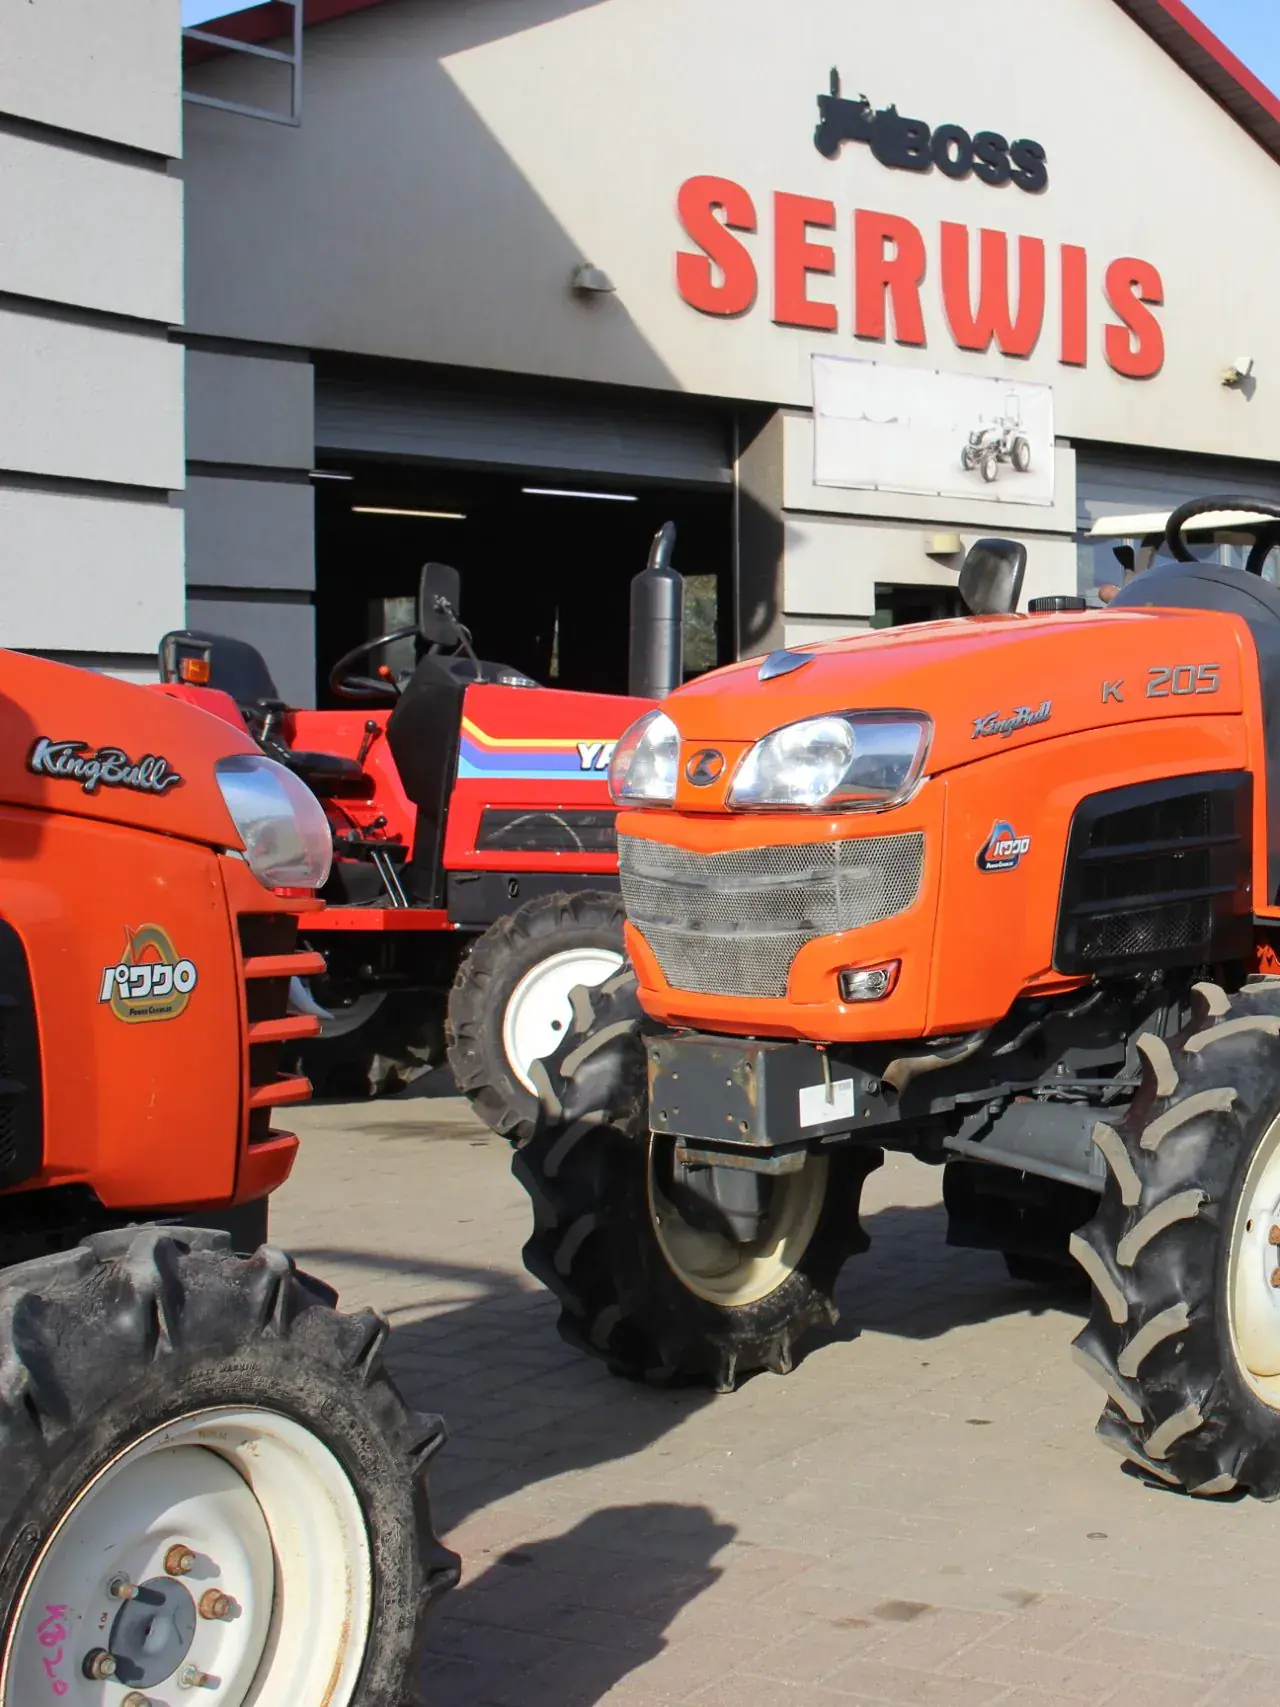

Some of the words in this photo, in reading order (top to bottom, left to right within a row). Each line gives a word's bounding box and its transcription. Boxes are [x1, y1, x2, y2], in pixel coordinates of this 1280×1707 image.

[896, 114, 1048, 194] BOSS
[676, 175, 1165, 380] SERWIS
[1102, 679, 1124, 703] K
[1146, 663, 1220, 698] 205
[971, 700, 1052, 739] KingBull
[27, 736, 183, 795] KingBull
